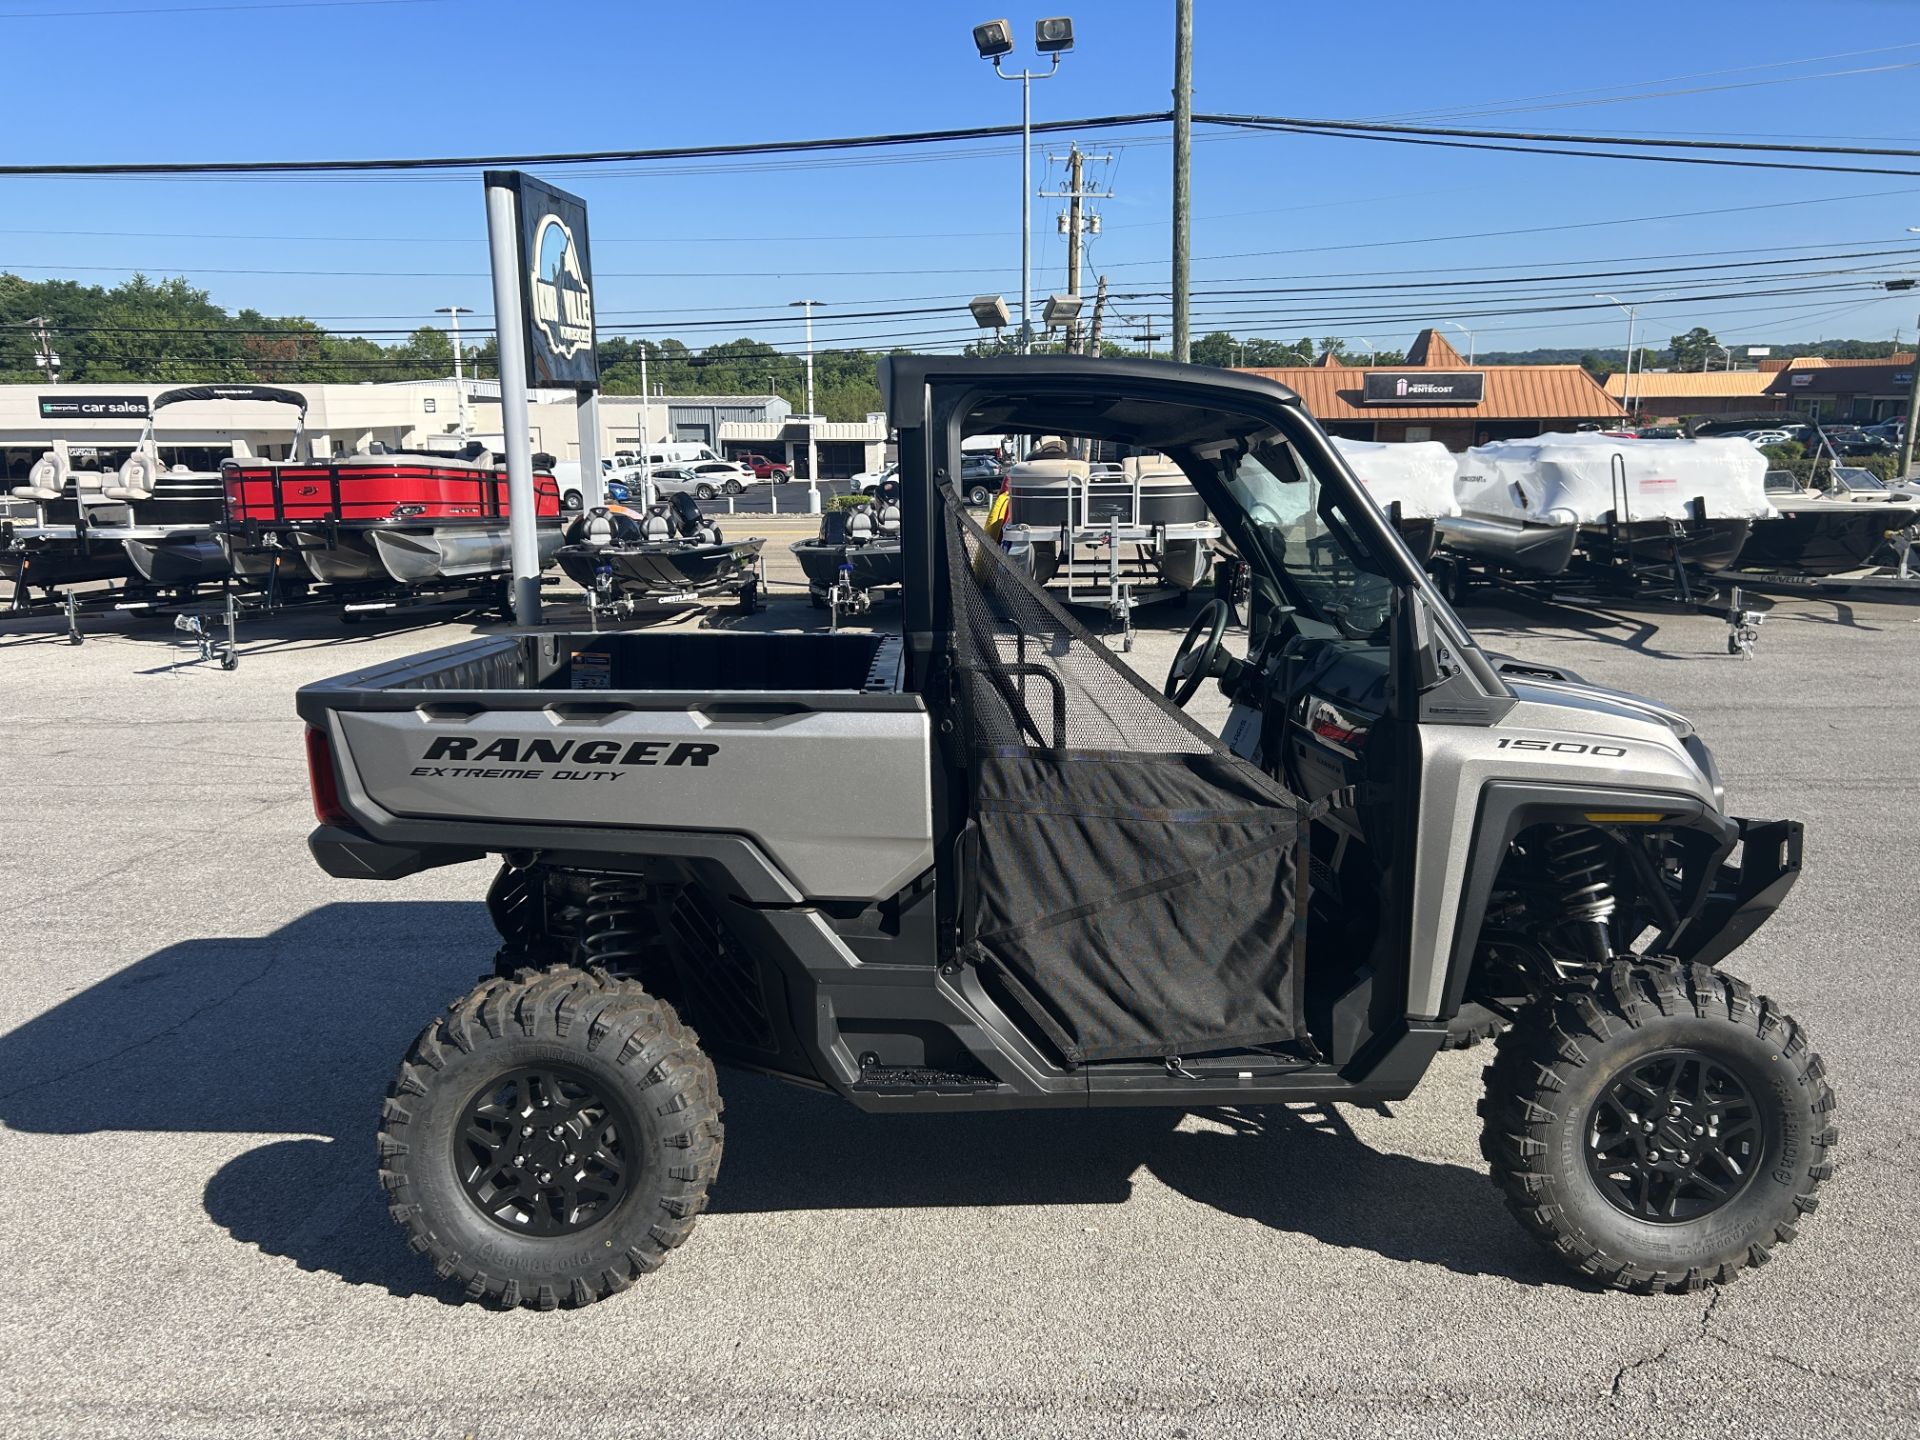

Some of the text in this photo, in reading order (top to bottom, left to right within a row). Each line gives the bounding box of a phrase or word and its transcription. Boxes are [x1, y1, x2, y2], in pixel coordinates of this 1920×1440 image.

[82, 404, 106, 412] car
[108, 401, 147, 412] sales
[422, 736, 720, 767] RANGER
[1498, 739, 1627, 758] 1500
[410, 767, 626, 782] EXTREME DUTY
[1561, 1105, 1581, 1188] TERRAIN
